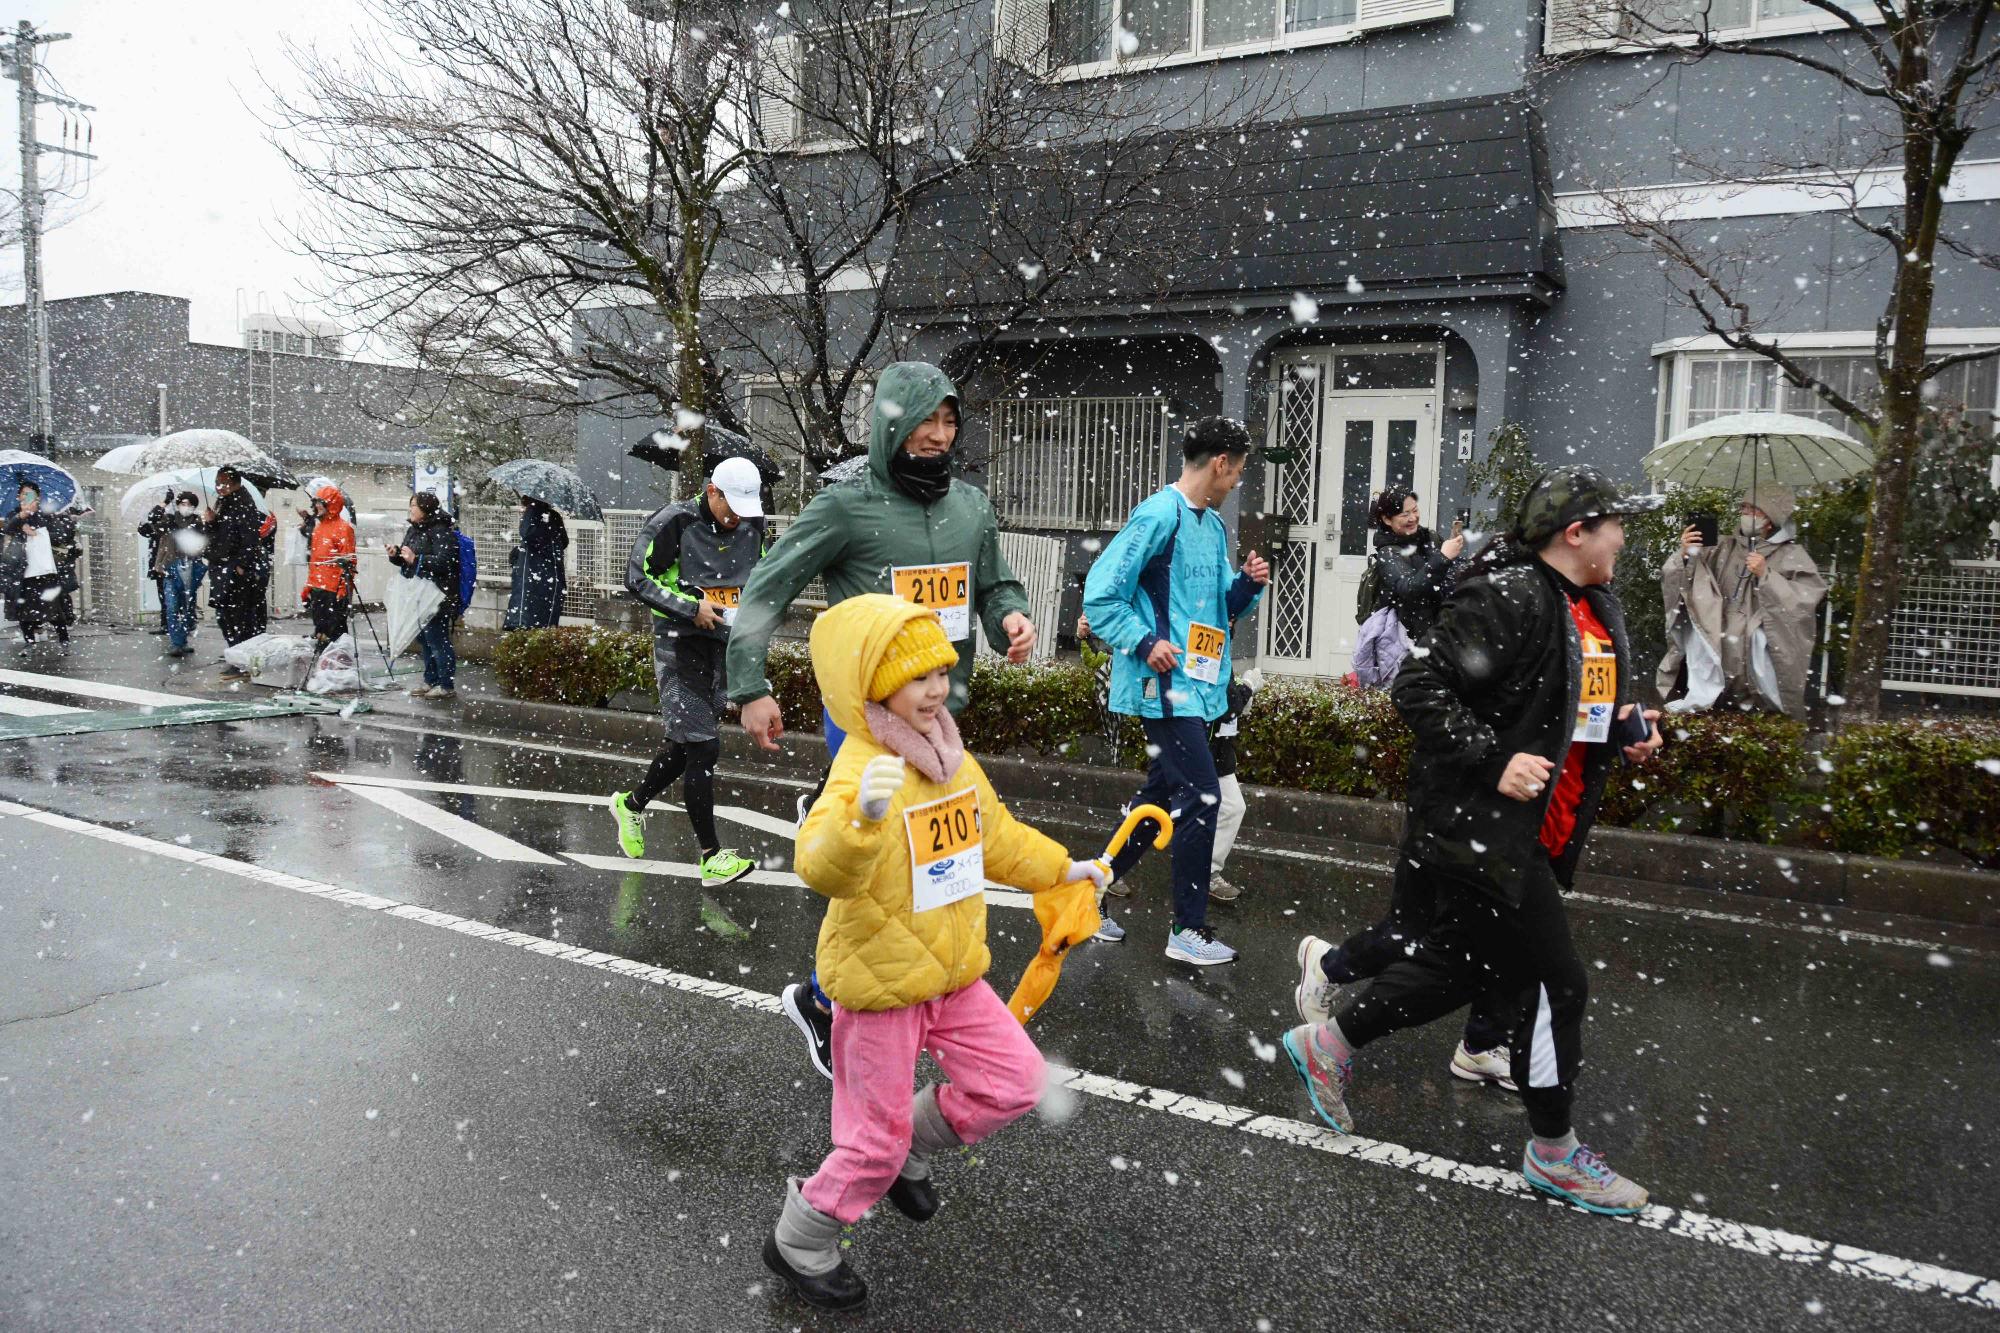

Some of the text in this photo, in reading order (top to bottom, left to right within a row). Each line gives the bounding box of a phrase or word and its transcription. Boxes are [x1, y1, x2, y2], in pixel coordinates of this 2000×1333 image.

[912, 576, 966, 604] 210 A
[1587, 667, 1611, 696] 251
[930, 808, 968, 852] 210
